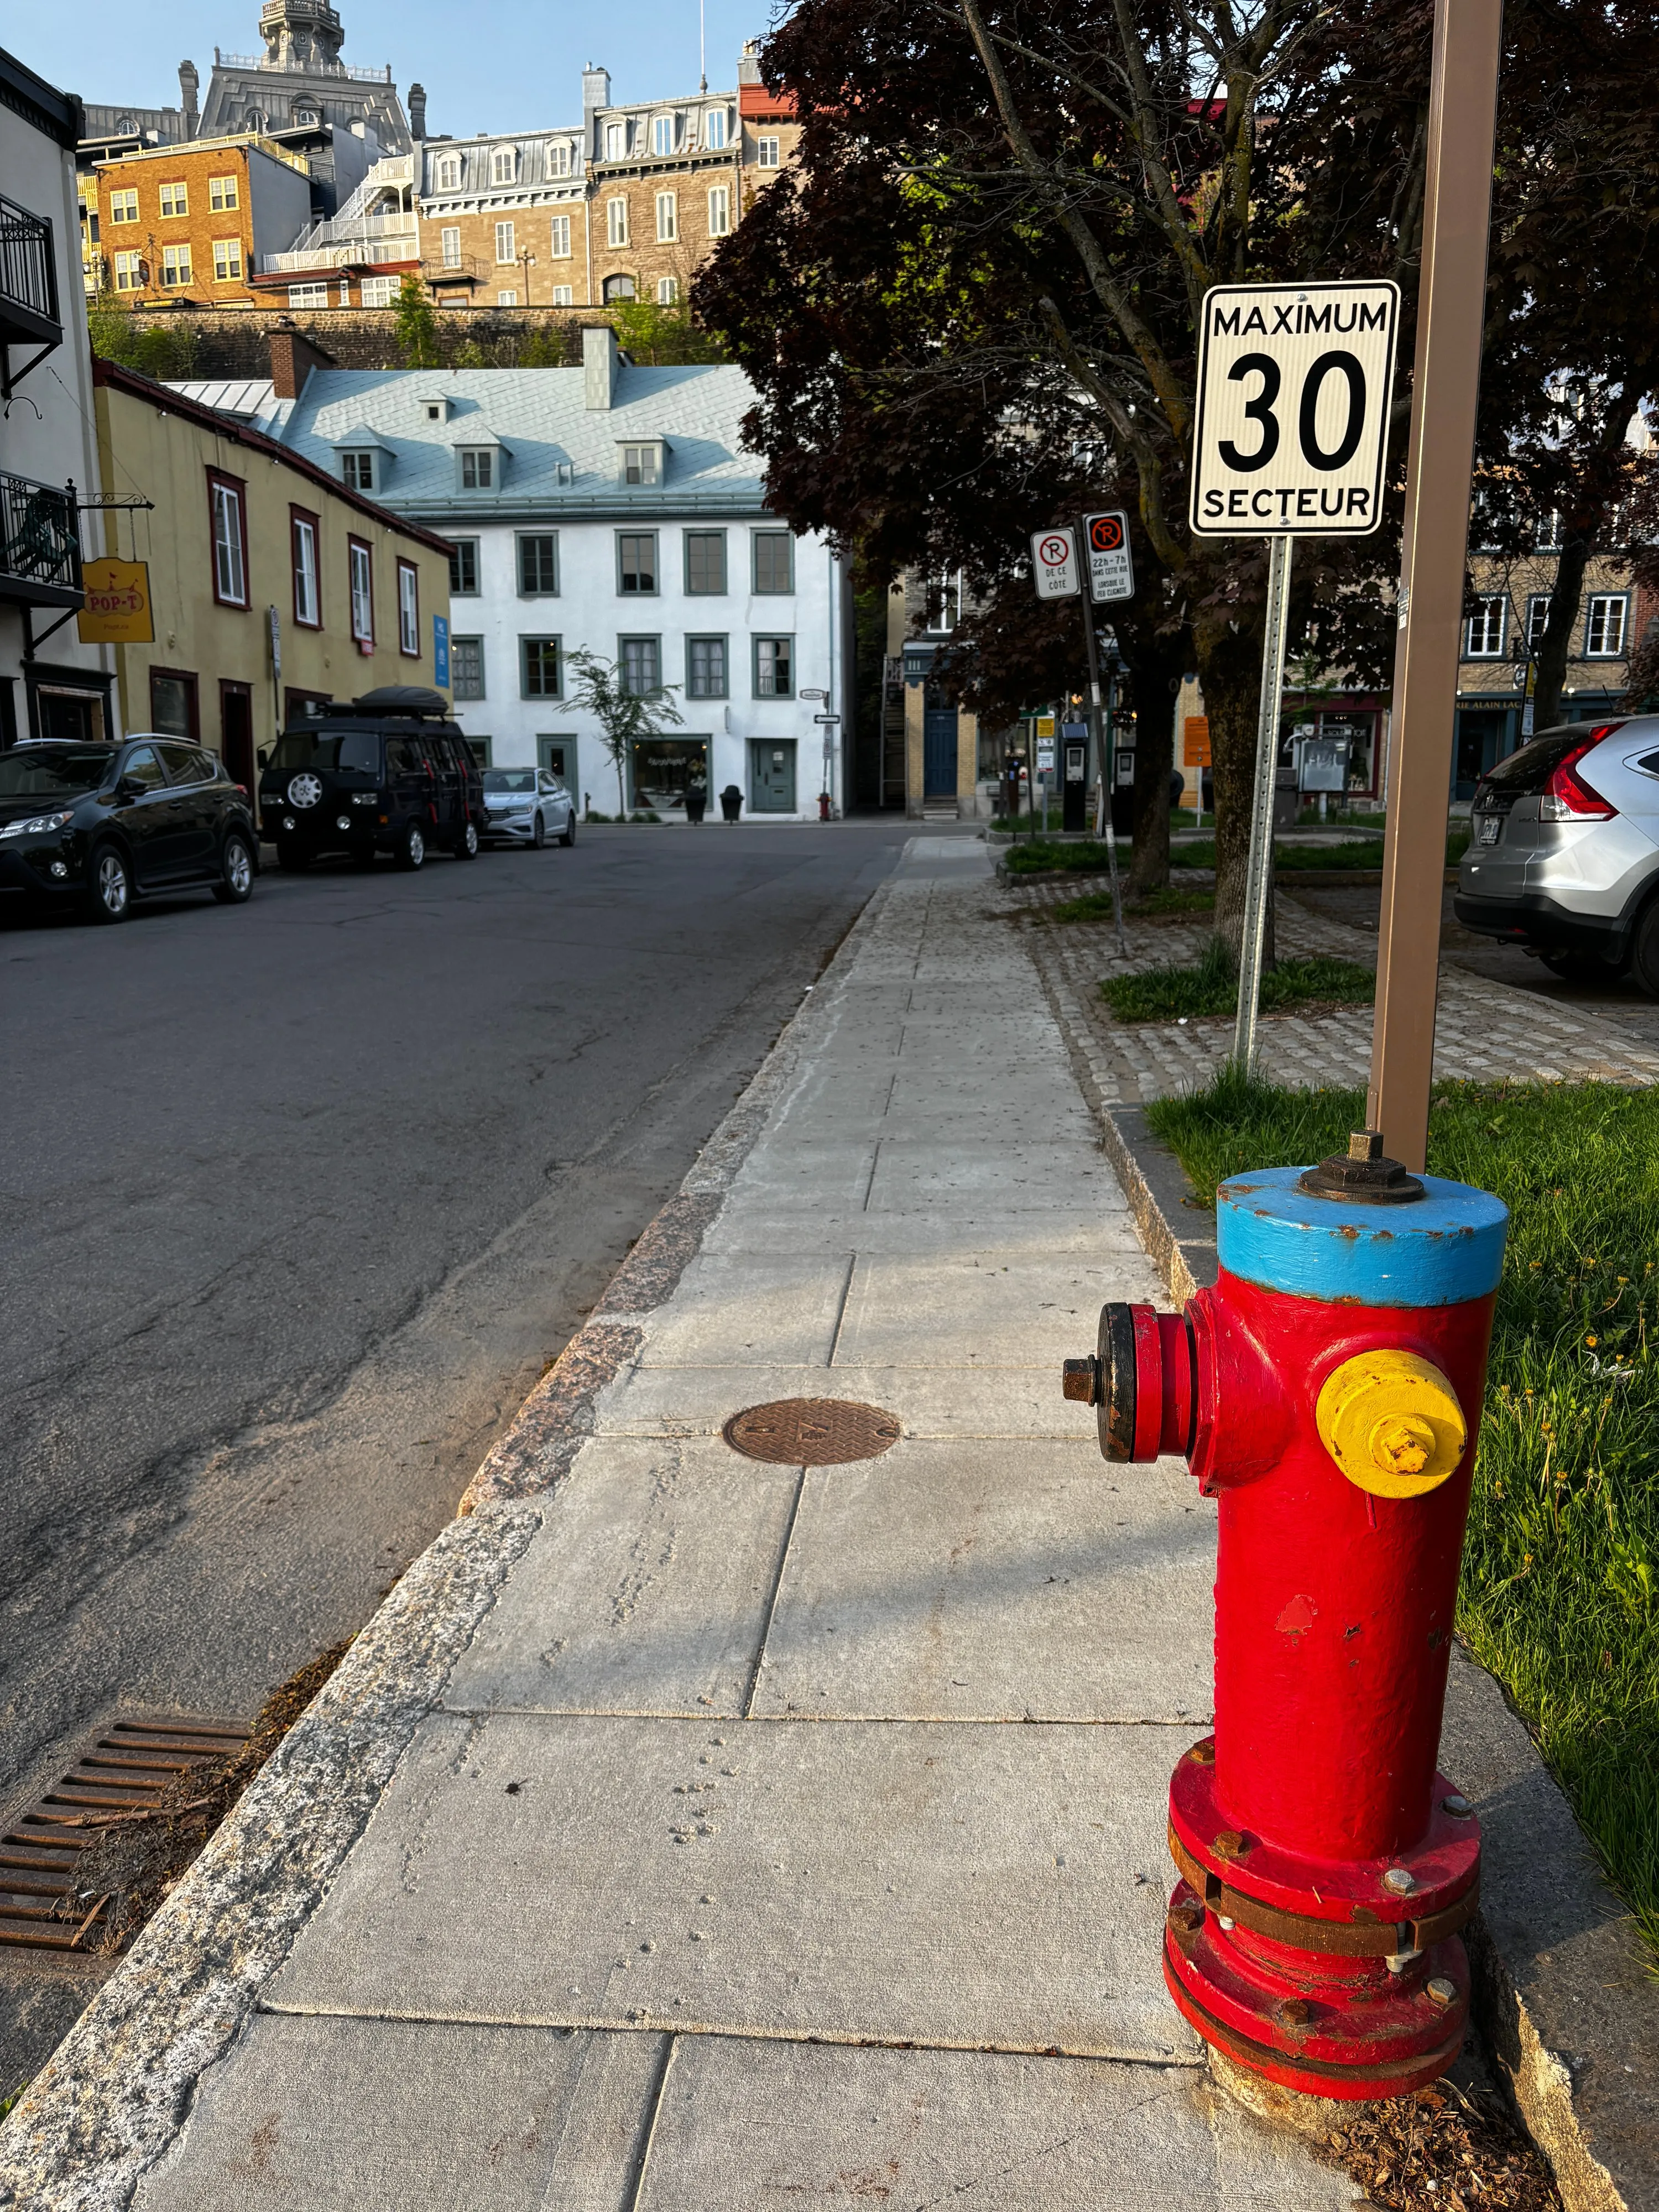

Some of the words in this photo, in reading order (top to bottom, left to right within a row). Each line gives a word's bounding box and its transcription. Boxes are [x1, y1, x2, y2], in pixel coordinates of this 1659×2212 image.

[1214, 302, 1387, 336] MAXIMUM
[1218, 350, 1366, 473] 30
[1203, 488, 1370, 518] SECTEUR
[1046, 568, 1055, 577] DE
[1057, 566, 1067, 576] CE
[90, 596, 137, 611] POP-T
